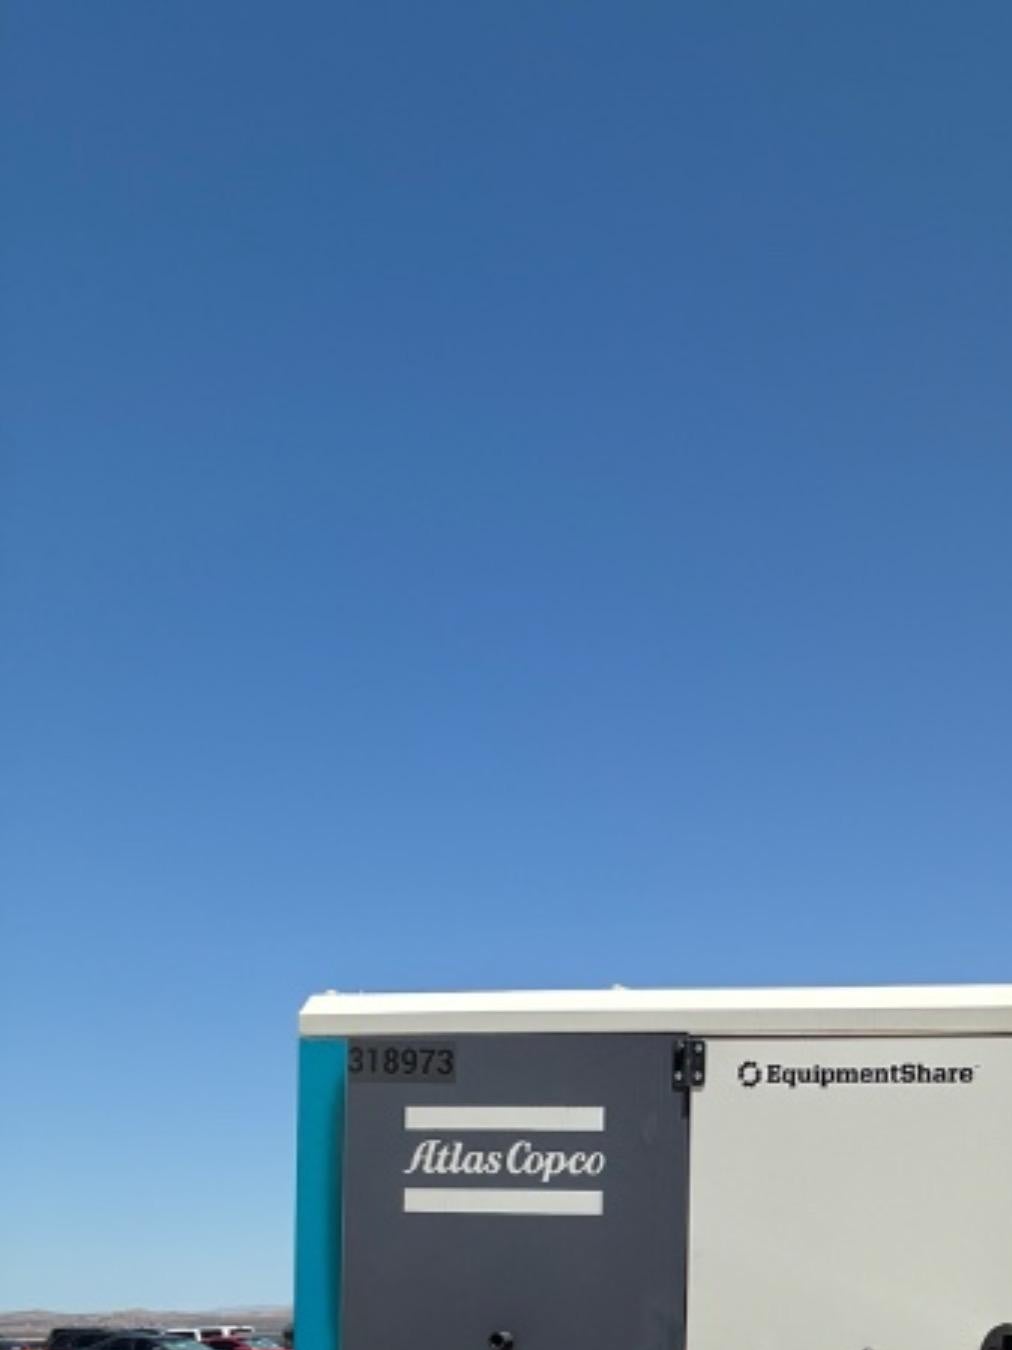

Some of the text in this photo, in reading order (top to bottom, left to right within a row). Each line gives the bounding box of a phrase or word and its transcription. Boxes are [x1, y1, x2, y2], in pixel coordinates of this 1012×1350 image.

[348, 1046, 455, 1075] 318973
[766, 1064, 974, 1088] EquipmentShare
[402, 1139, 606, 1183] Atlas Copco
